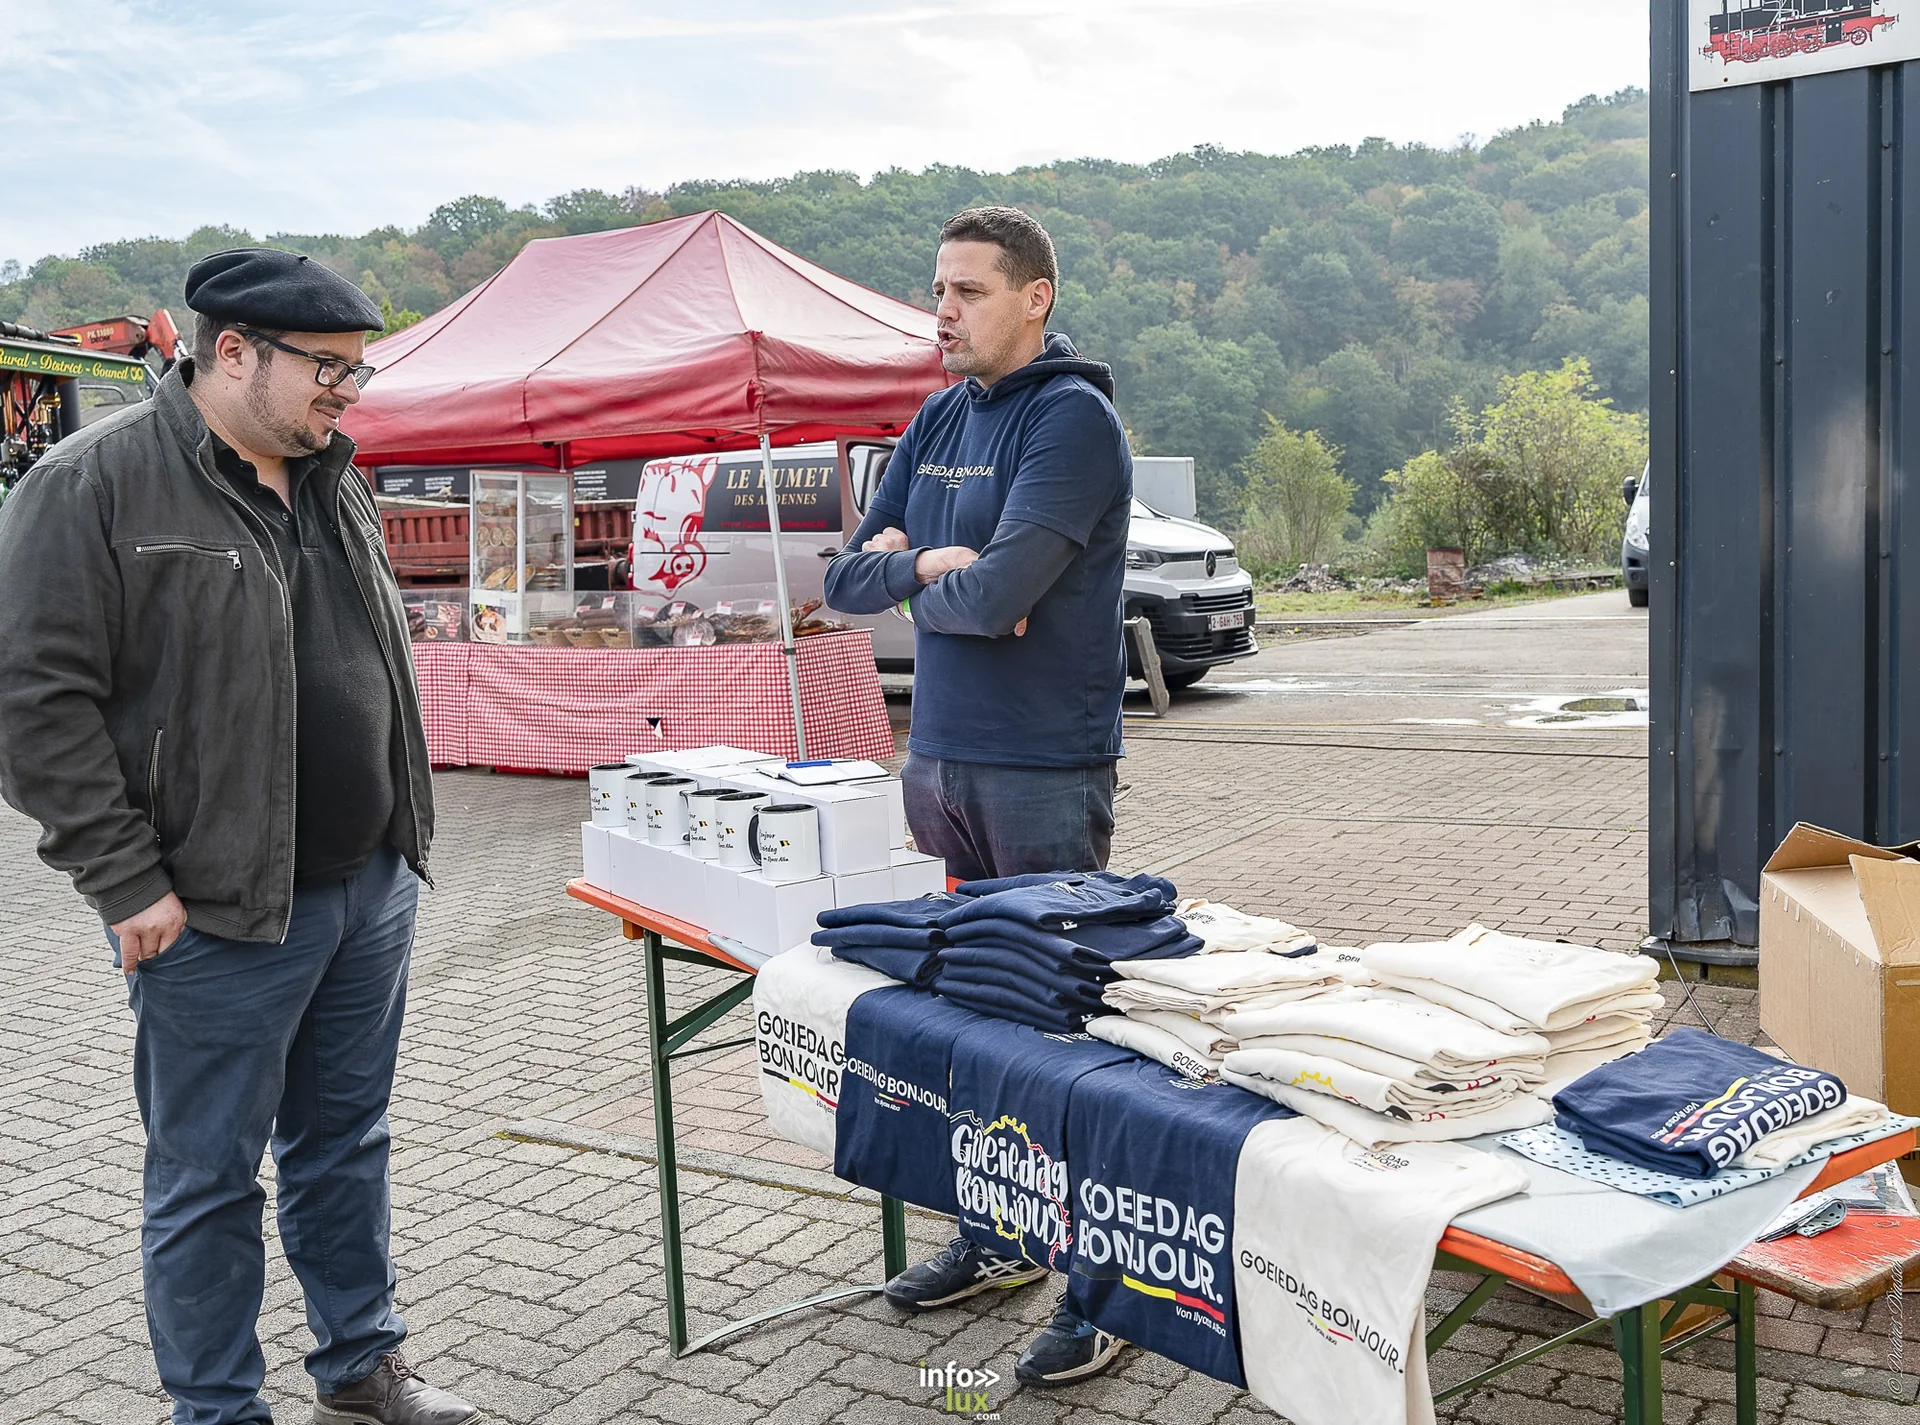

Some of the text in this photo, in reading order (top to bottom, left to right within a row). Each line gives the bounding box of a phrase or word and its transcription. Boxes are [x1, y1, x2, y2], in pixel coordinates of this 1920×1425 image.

[40, 355, 82, 374] District
[92, 363, 128, 380] Council
[726, 469, 751, 489] LE
[734, 495, 754, 506] DES
[758, 1011, 845, 1067] GOEIEDAG
[886, 1078, 951, 1118] BONJOUR.
[1674, 1068, 1822, 1148] BONJOUR.
[1682, 1101, 1700, 1114] Von
[1707, 1079, 1842, 1169] GOEIEDAG
[1176, 1305, 1192, 1320] Von
[1240, 1250, 1404, 1374] GOEIEDAG BONJOUR.
